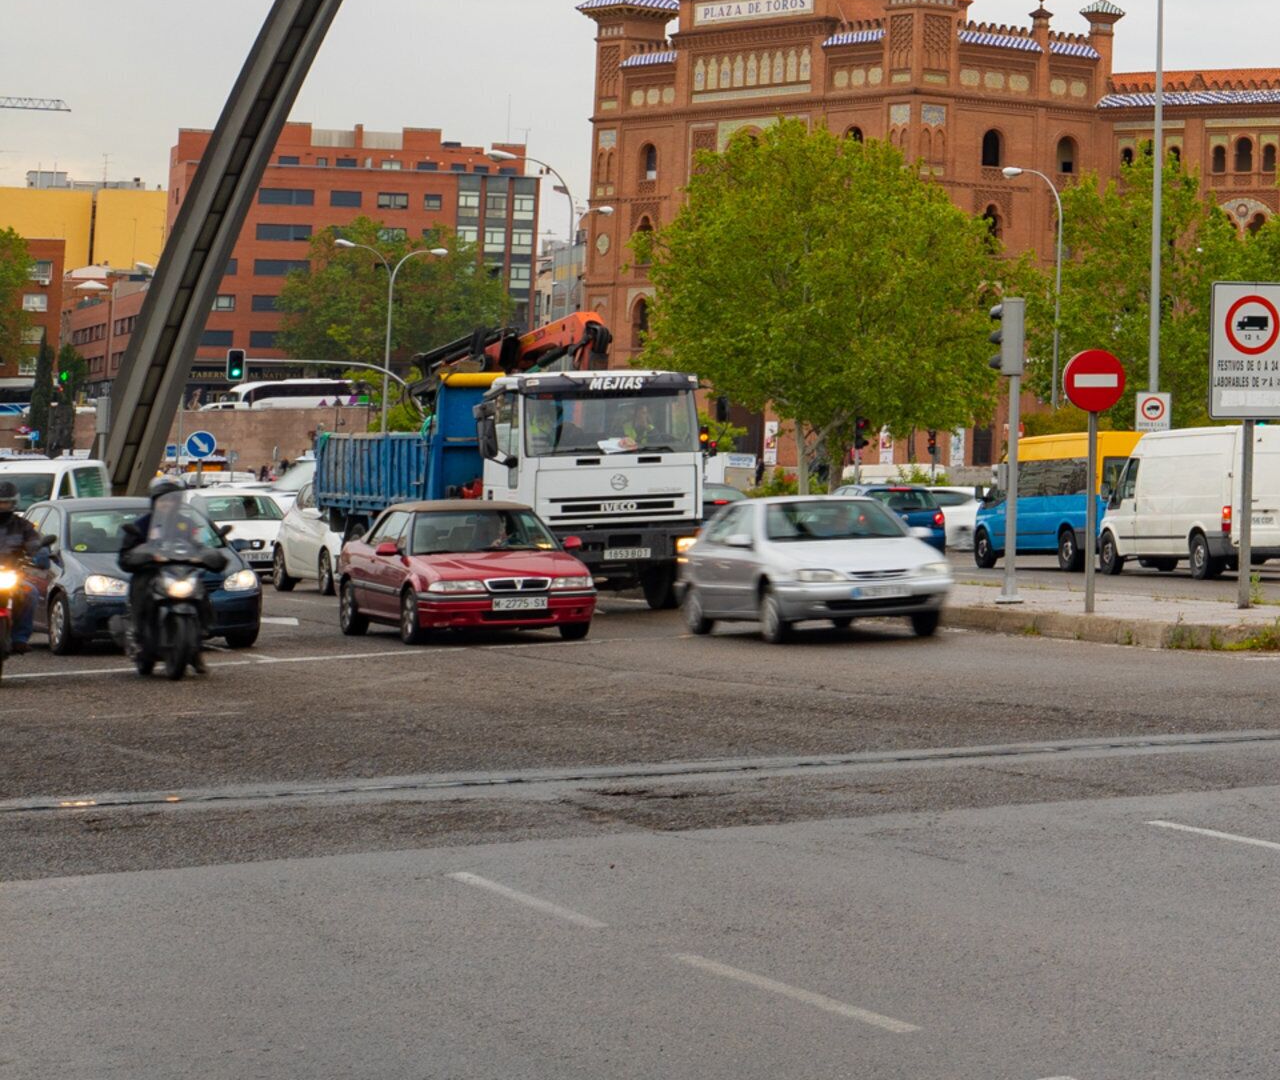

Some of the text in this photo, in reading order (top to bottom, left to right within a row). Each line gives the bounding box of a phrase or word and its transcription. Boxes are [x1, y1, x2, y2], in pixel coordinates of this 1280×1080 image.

[703, 5, 743, 18] PLAZA
[748, 2, 761, 13] DE
[1217, 360, 1244, 371] FESTIVOS
[1247, 360, 1254, 371] DE
[1264, 360, 1269, 371] A
[1271, 360, 1279, 371] 24
[191, 371, 227, 379] TABERN
[589, 376, 644, 390] MEJIAS
[1213, 376, 1249, 388] LABORABLES
[1252, 376, 1259, 388] DE
[1261, 378, 1268, 386] 7
[1269, 376, 1273, 387] A
[601, 502, 638, 513] IVECO
